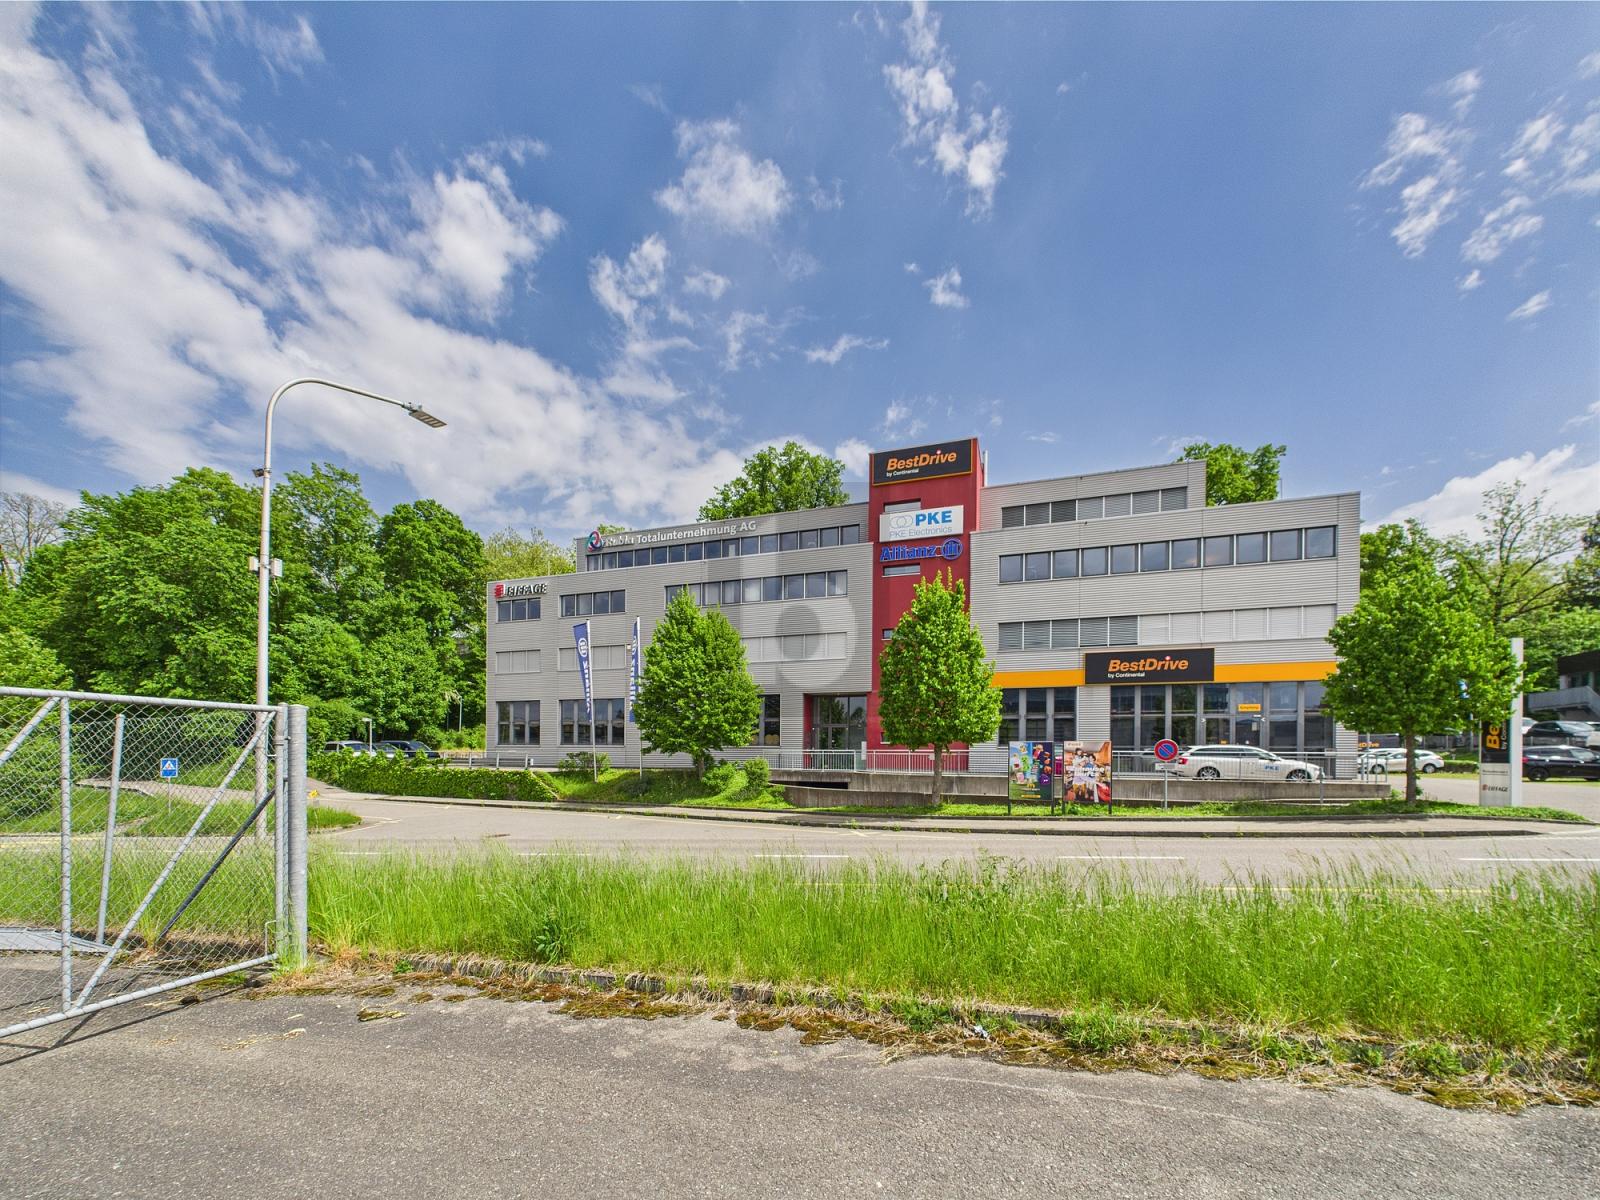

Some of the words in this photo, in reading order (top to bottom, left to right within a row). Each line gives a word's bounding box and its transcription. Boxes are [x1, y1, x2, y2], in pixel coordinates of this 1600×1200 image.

[887, 449, 957, 471] BestDrive
[915, 510, 952, 526] PKE
[637, 524, 736, 544] Totalunternehmung
[739, 520, 757, 531] AG
[889, 530, 906, 538] PKE
[908, 526, 953, 537] Electronics
[880, 544, 936, 561] Allianz
[1108, 655, 1189, 672] BestDrive
